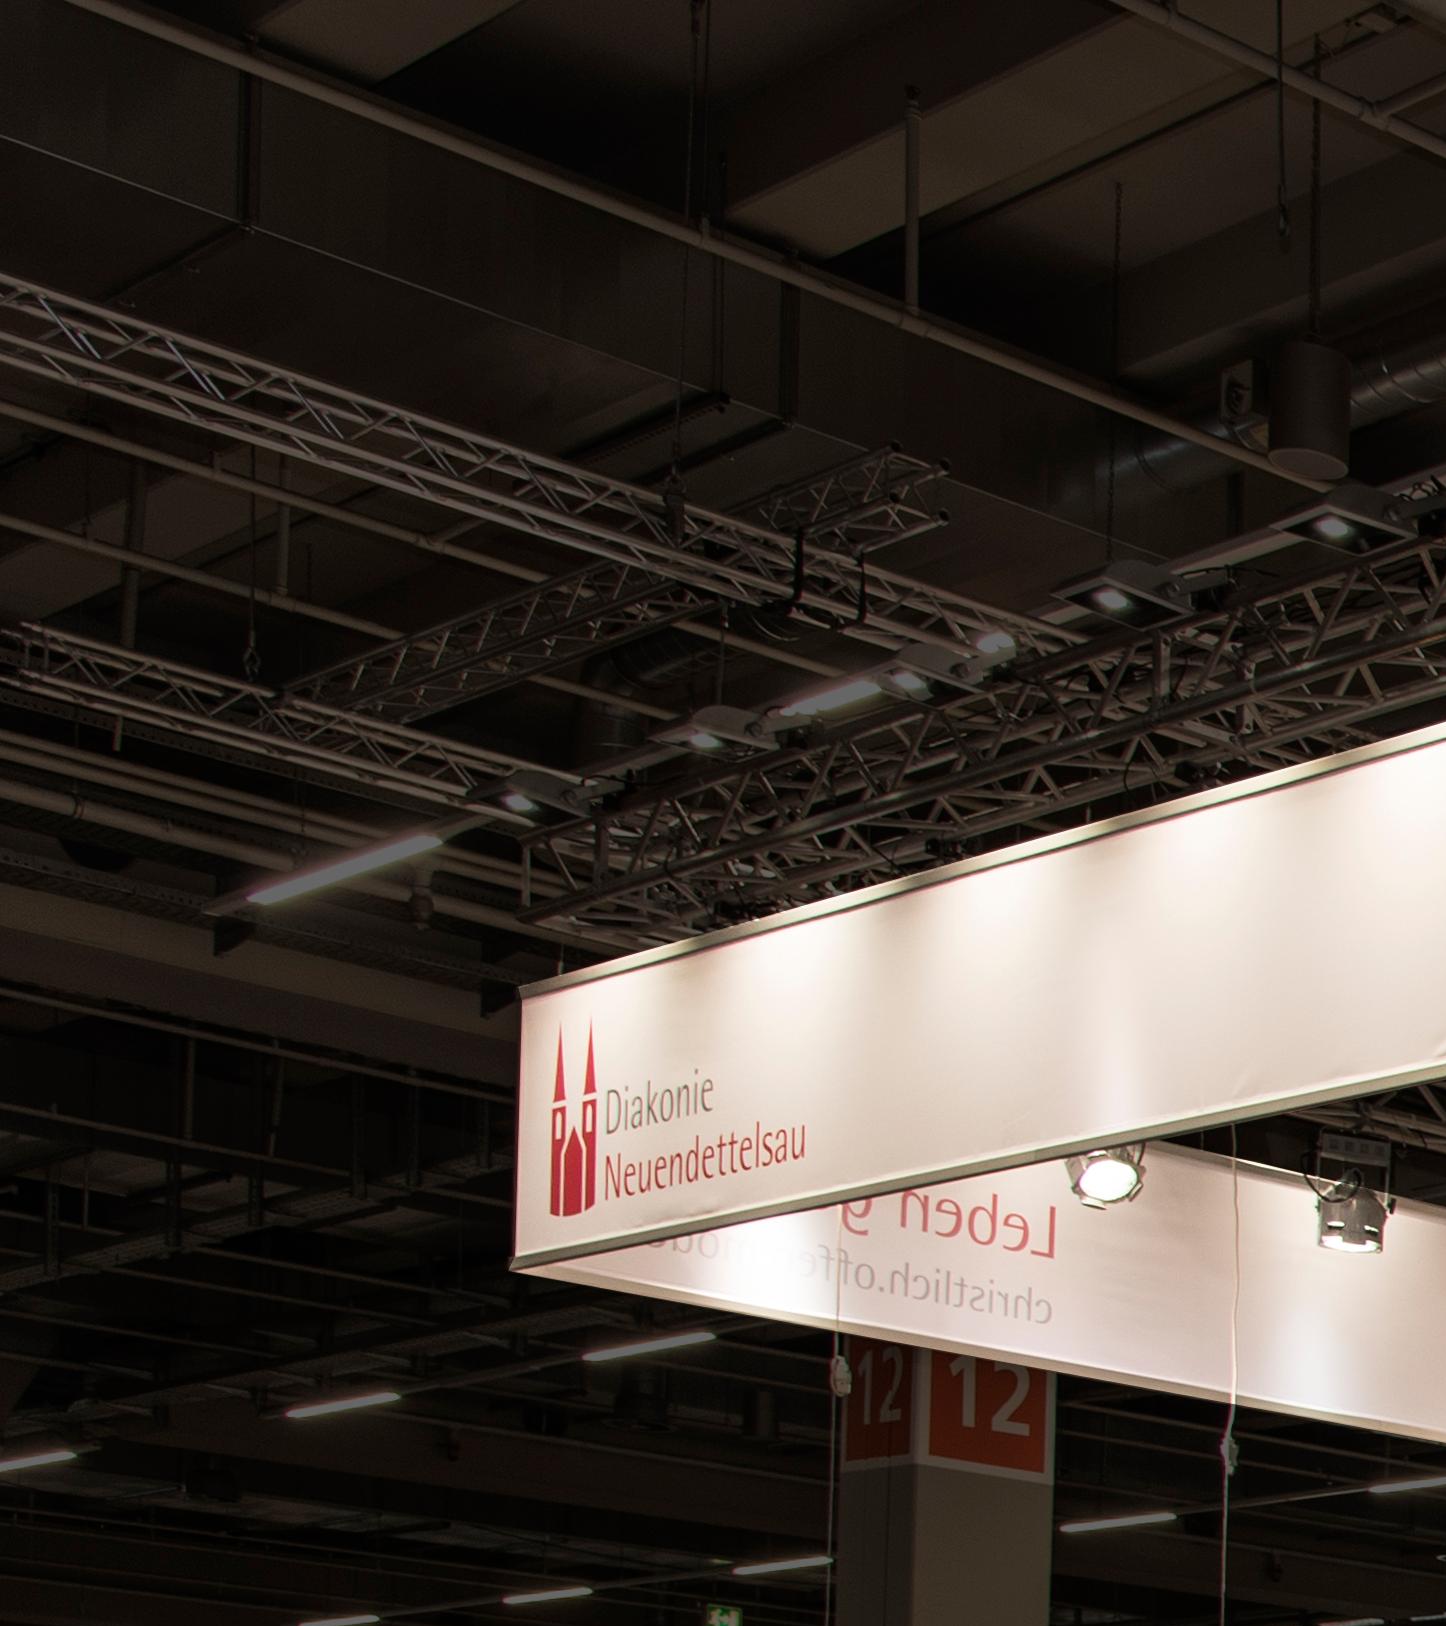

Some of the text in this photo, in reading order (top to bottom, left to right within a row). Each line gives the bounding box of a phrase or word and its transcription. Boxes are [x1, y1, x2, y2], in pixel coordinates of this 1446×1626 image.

[606, 1068, 714, 1135] Diakonie
[604, 1120, 806, 1201] Neuendettelsau
[858, 1345, 904, 1425] 12
[949, 1355, 1031, 1437] 12
